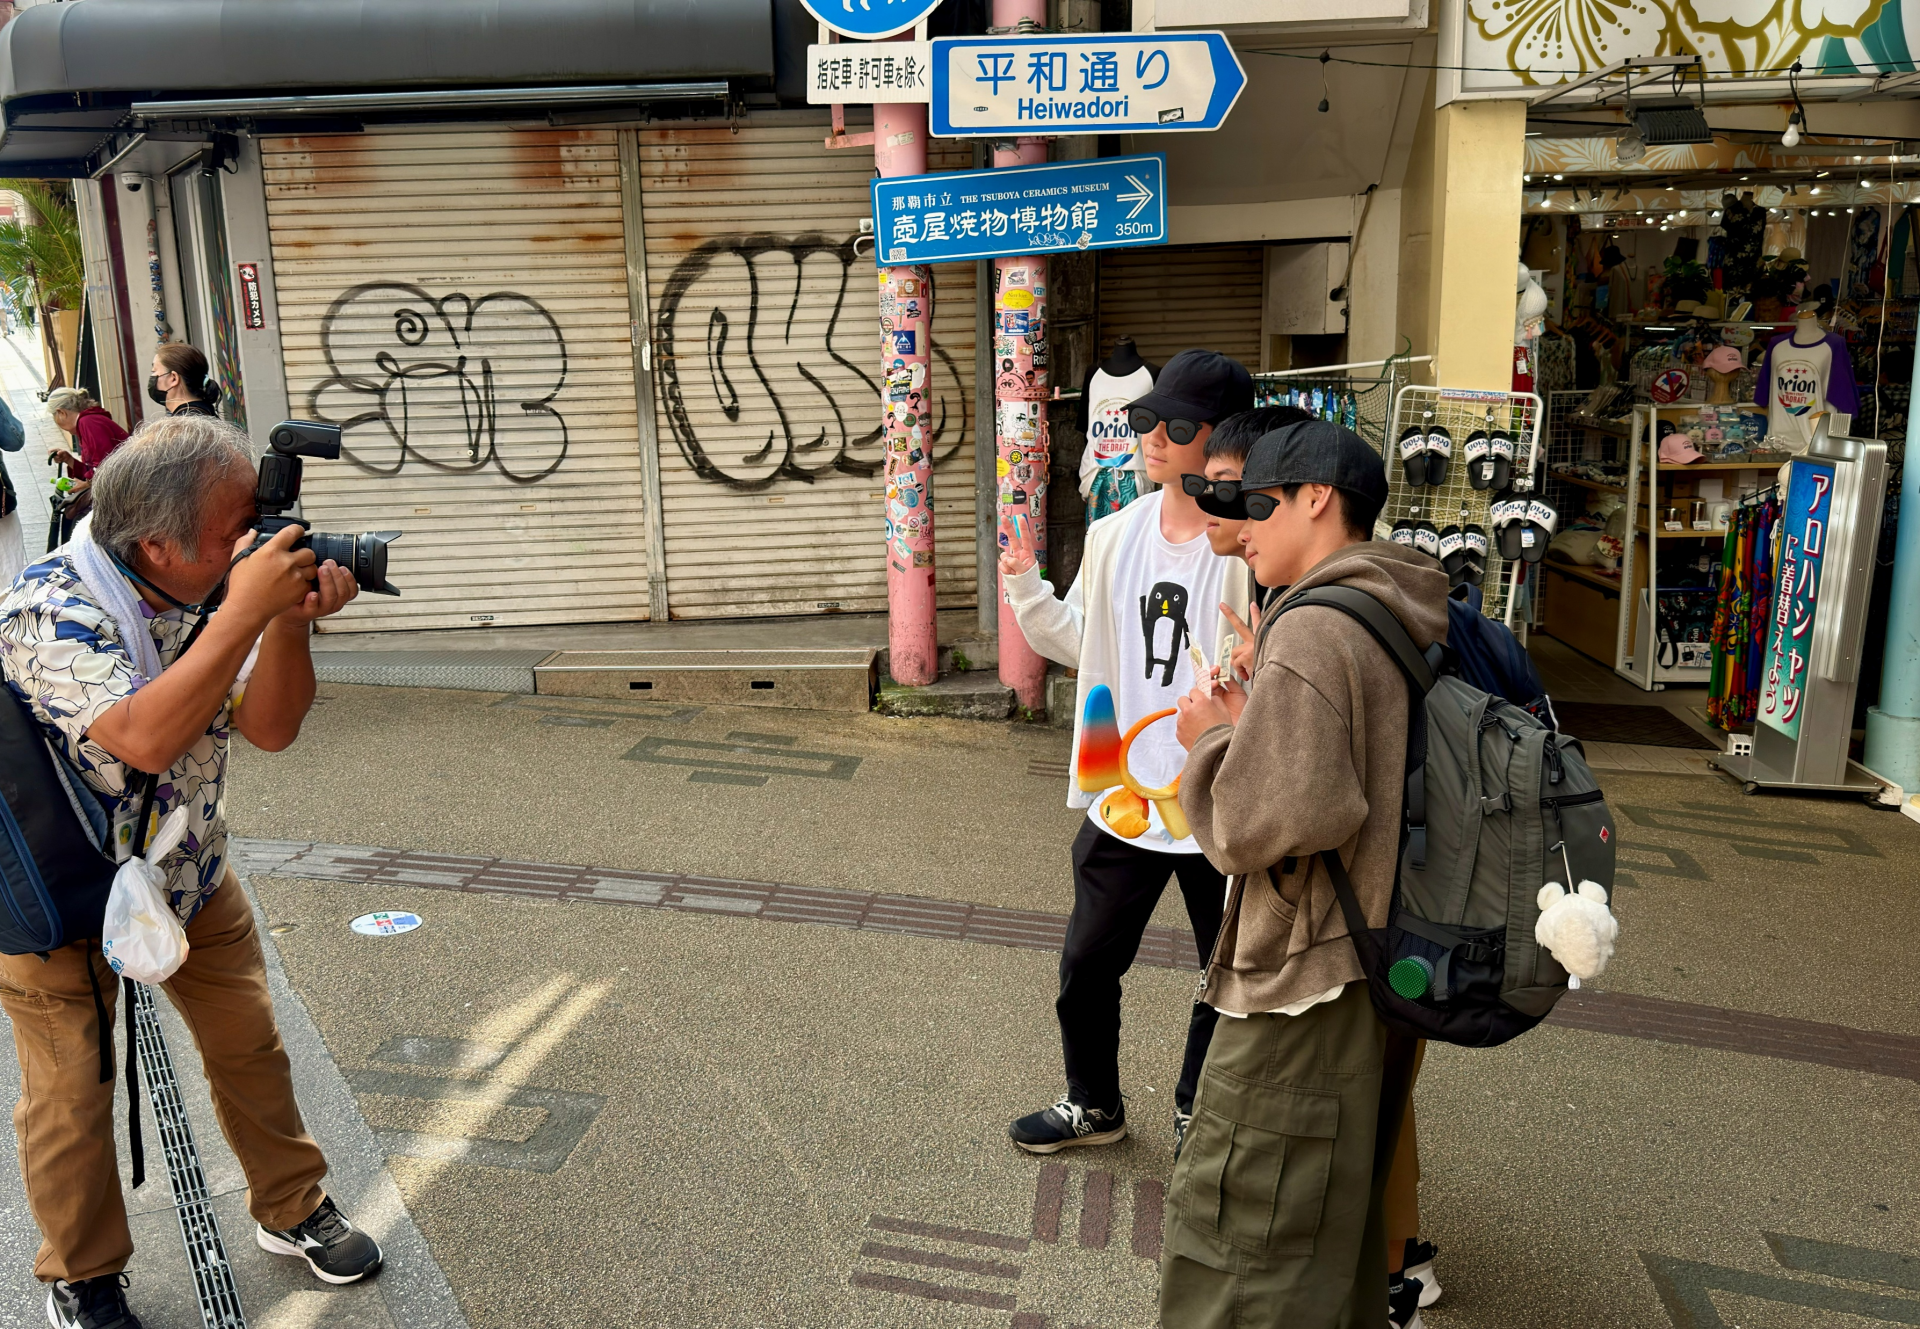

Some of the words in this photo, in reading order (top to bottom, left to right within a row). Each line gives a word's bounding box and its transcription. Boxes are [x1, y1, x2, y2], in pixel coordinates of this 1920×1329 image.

[817, 56, 926, 91] 指定車・許可車を除く
[975, 49, 1171, 97] 平和通り
[1017, 95, 1130, 121] Heiwadori
[891, 191, 954, 212] 那覇市立
[960, 194, 978, 205] THE
[980, 191, 1020, 203] TSUBOYA
[1022, 186, 1068, 199] CERAMICS
[1071, 182, 1110, 195] MUSEUM
[892, 200, 1099, 245] 壺屋焼物博物館
[1115, 222, 1154, 236] 350m
[248, 281, 262, 327] 防犯カメラ
[1098, 443, 1110, 452] THE
[1110, 443, 1130, 452] DRAFT
[1781, 473, 1830, 724] アロハシャツ
[1765, 533, 1799, 714] に着替えよう
